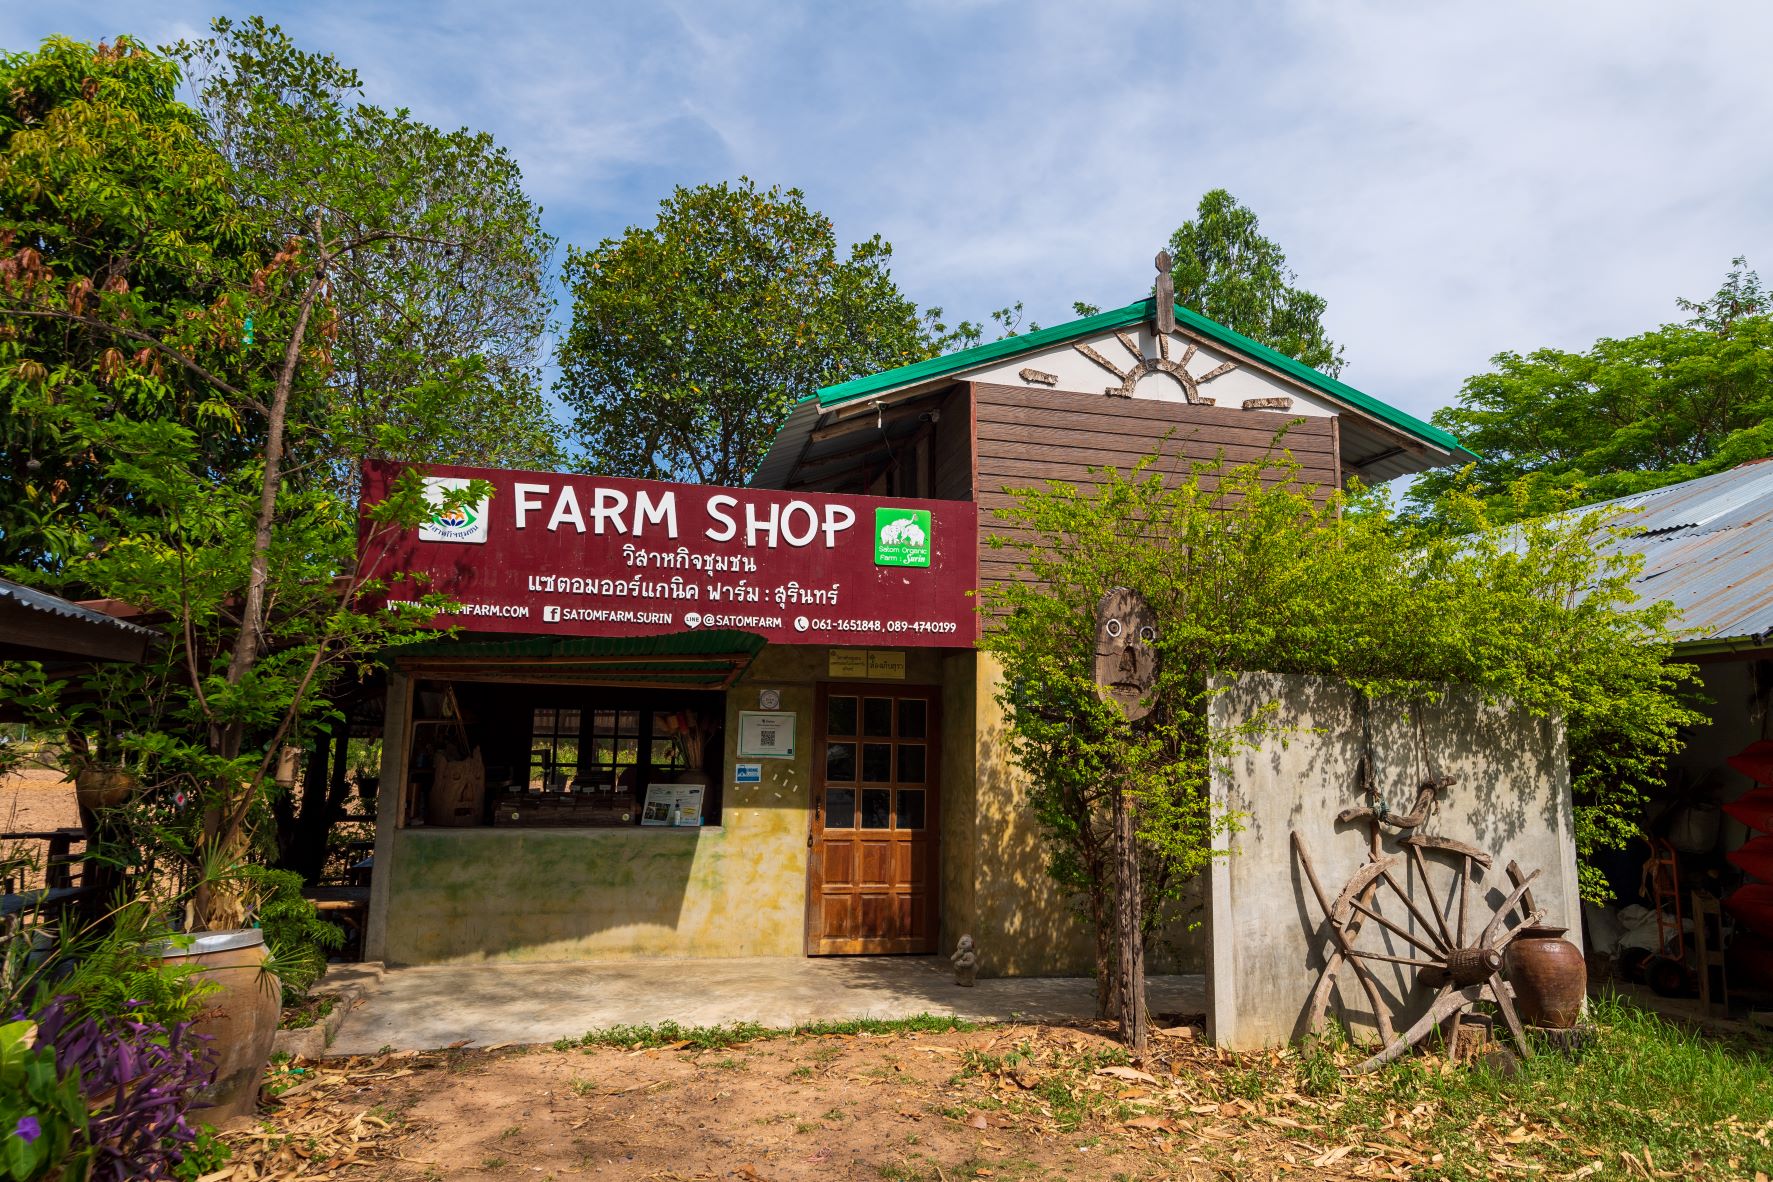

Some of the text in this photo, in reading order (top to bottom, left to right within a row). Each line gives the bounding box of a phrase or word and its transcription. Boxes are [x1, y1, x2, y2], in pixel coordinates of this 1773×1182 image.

[514, 482, 856, 548] FARM SHOP
[879, 545, 927, 555] Satom Organic
[623, 543, 757, 576] วิสาหกิจชุมชน
[903, 553, 926, 564] Surin
[528, 574, 699, 600] แซตอมออร์แกนิค
[707, 582, 759, 602] ฟาร์ม
[774, 581, 840, 610] สุรินทร์
[563, 608, 672, 624] SATOMFARM.SURIN
[703, 613, 782, 628] @SATOMFARM
